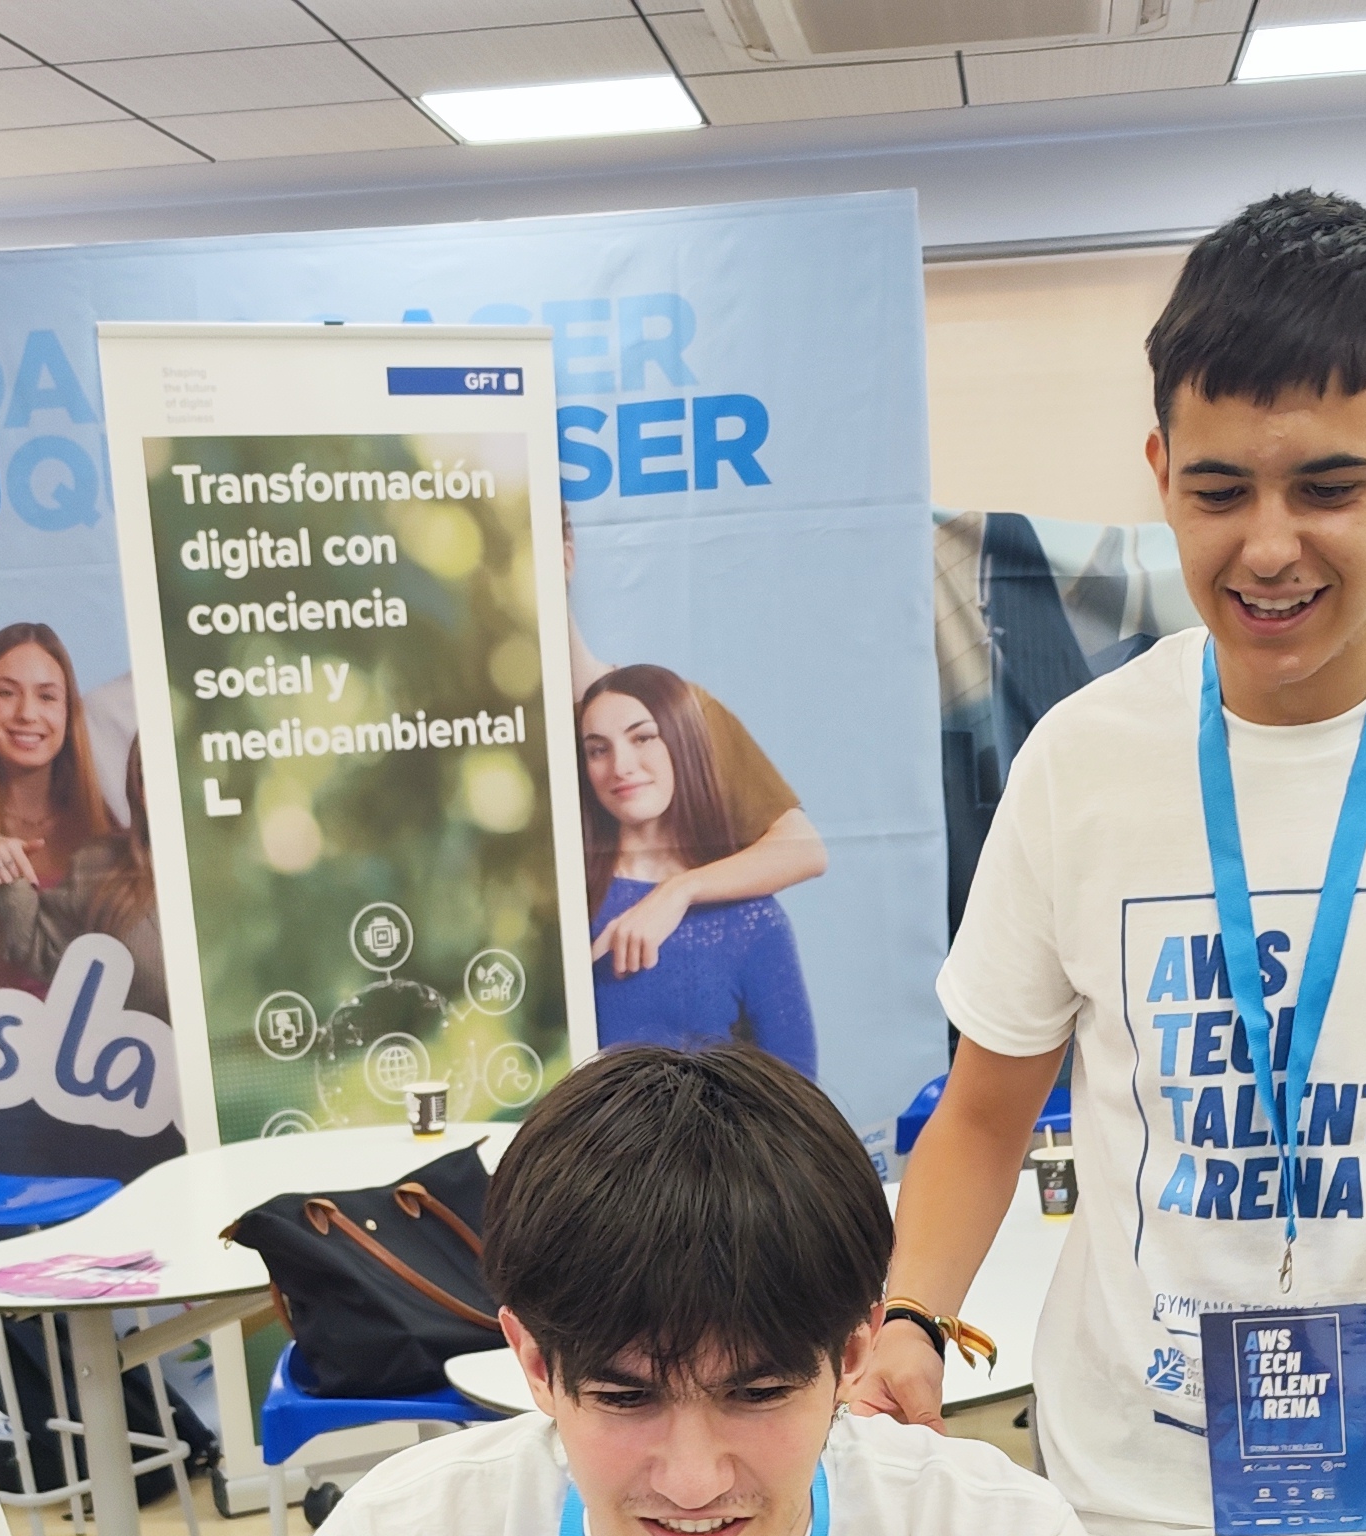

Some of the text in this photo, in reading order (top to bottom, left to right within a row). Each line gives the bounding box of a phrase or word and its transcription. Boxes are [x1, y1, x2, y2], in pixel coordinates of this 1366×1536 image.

[463, 371, 499, 392] GFT
[555, 392, 772, 503] SER
[172, 459, 496, 506] Transformación
[180, 527, 398, 580] digital con
[187, 588, 408, 636] conciencia
[194, 655, 350, 702] social y
[201, 705, 527, 763] medioambiental
[1157, 1152, 1364, 1221] ARENA
[1244, 1327, 1292, 1352] AWS
[1245, 1350, 1302, 1376] TECH
[1247, 1372, 1331, 1399] TALENT
[1248, 1396, 1321, 1421] ARENA
